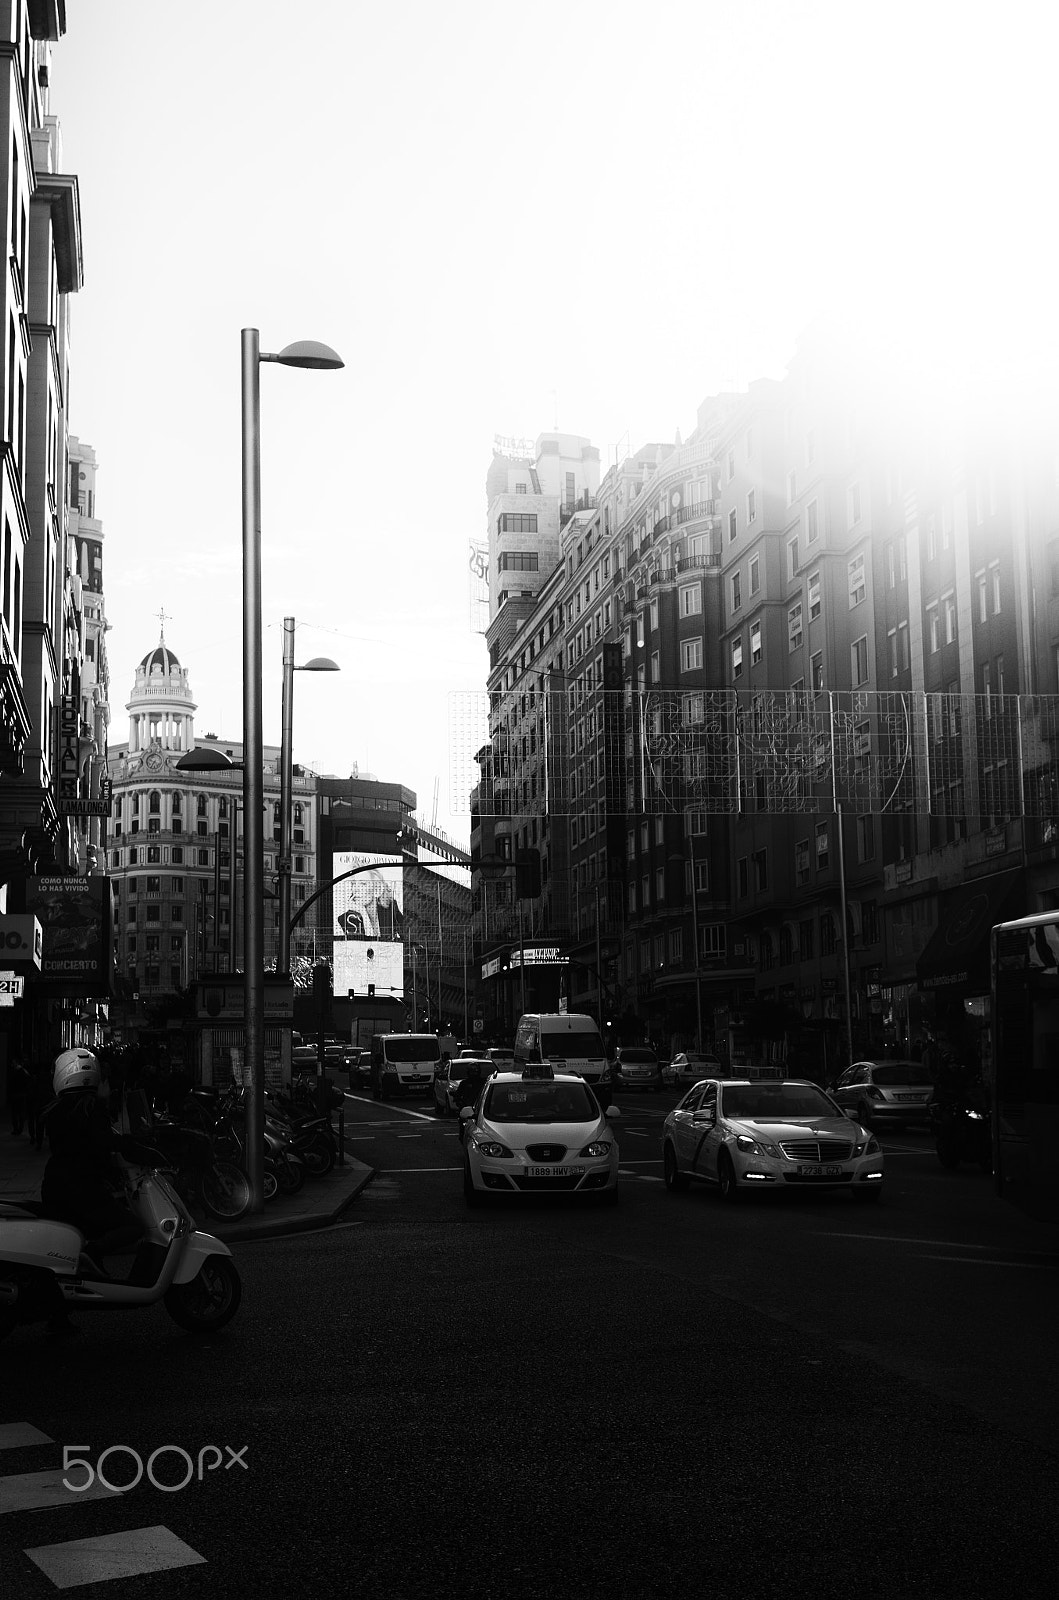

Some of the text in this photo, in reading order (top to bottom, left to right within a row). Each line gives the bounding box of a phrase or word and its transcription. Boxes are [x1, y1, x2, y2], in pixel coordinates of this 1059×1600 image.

[61, 696, 77, 772] HOSTAL
[61, 801, 108, 813] LAMALONGA
[339, 855, 371, 864] GIORGIO
[44, 960, 97, 970] CONCIERTO
[531, 1167, 551, 1176] 1889
